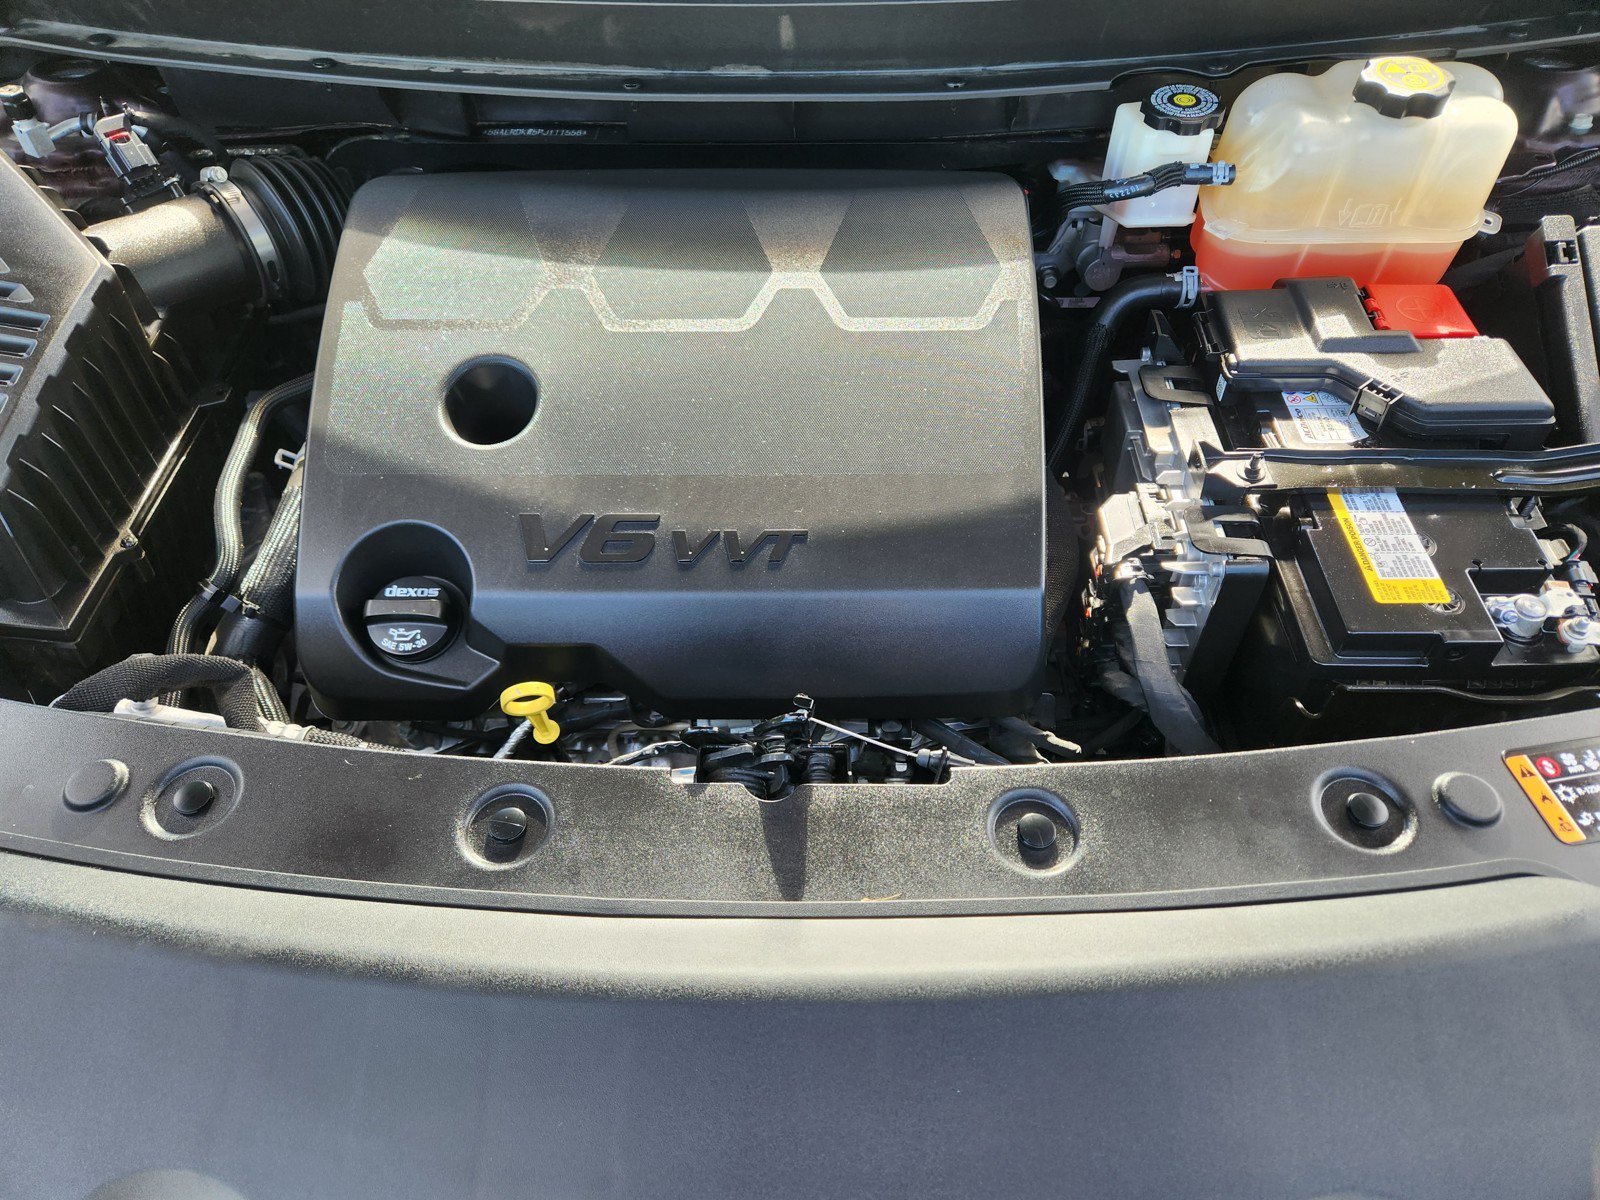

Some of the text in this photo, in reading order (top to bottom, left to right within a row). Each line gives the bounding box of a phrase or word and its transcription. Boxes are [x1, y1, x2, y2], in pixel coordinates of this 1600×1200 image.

[1341, 517, 1358, 539] POISON
[519, 513, 809, 563] V6 VVT
[384, 585, 441, 597] dexos
[381, 638, 428, 651] SAE 5W-30
